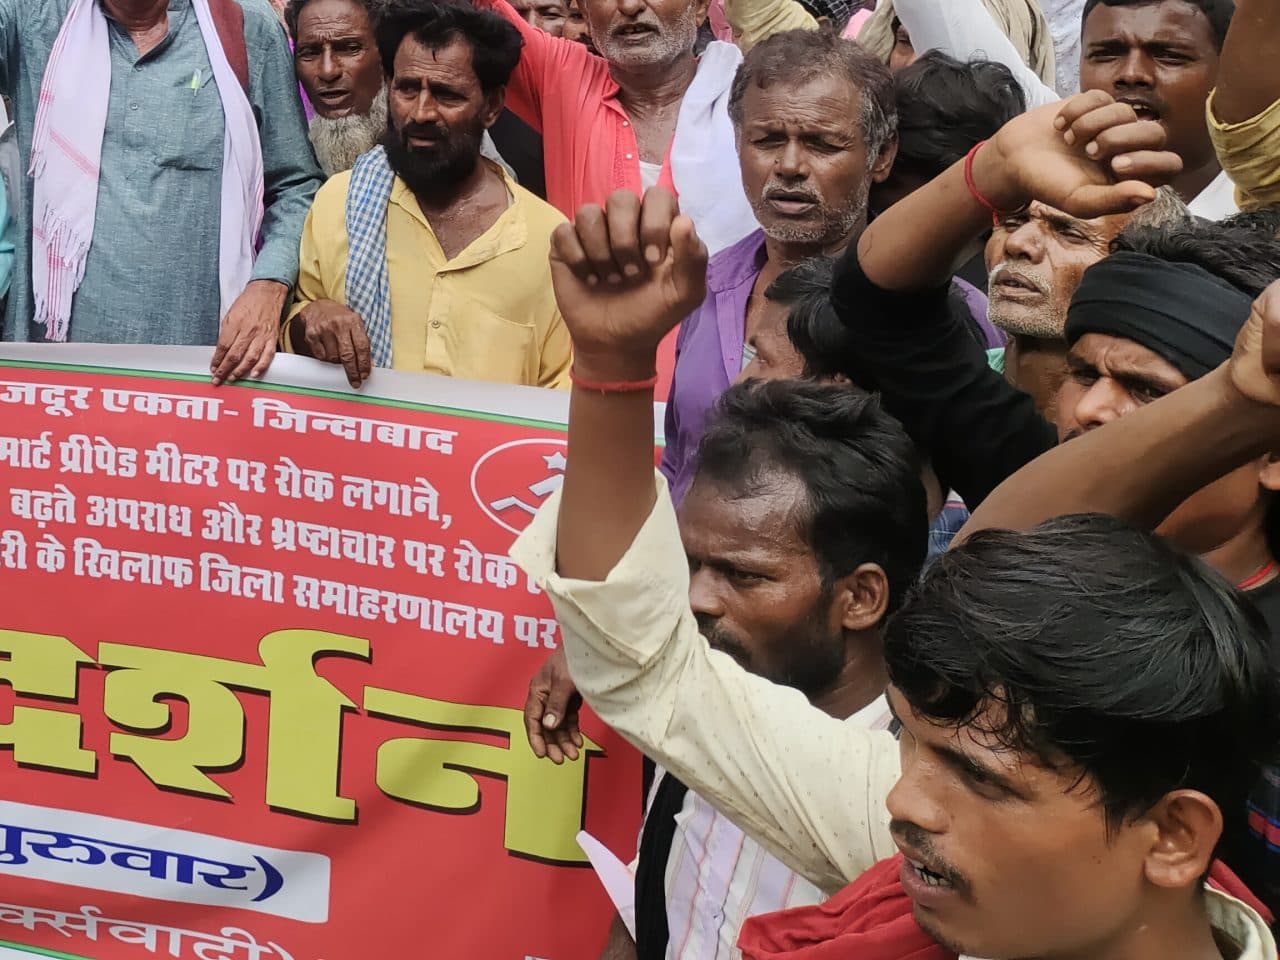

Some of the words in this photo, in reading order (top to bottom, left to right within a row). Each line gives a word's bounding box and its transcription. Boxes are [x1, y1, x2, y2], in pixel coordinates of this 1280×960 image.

[252, 398, 458, 455] जिन्दाबाद
[59, 434, 138, 478] प्रीपेड
[145, 442, 220, 488] मीटर
[226, 457, 267, 494] पर
[274, 455, 335, 503] रोक
[341, 475, 453, 529] लगाने,
[10, 482, 77, 529] बढ़ते
[86, 496, 193, 538] अपराध
[202, 501, 262, 546] और
[271, 517, 396, 569] भ्रष्टाचार
[404, 540, 445, 577] पर
[453, 539, 519, 589] रोक
[36, 534, 66, 573] के
[74, 537, 194, 589] खिलाफ
[199, 552, 285, 604] जिला
[292, 574, 505, 645] समाहरणालय
[513, 614, 559, 650] पर
